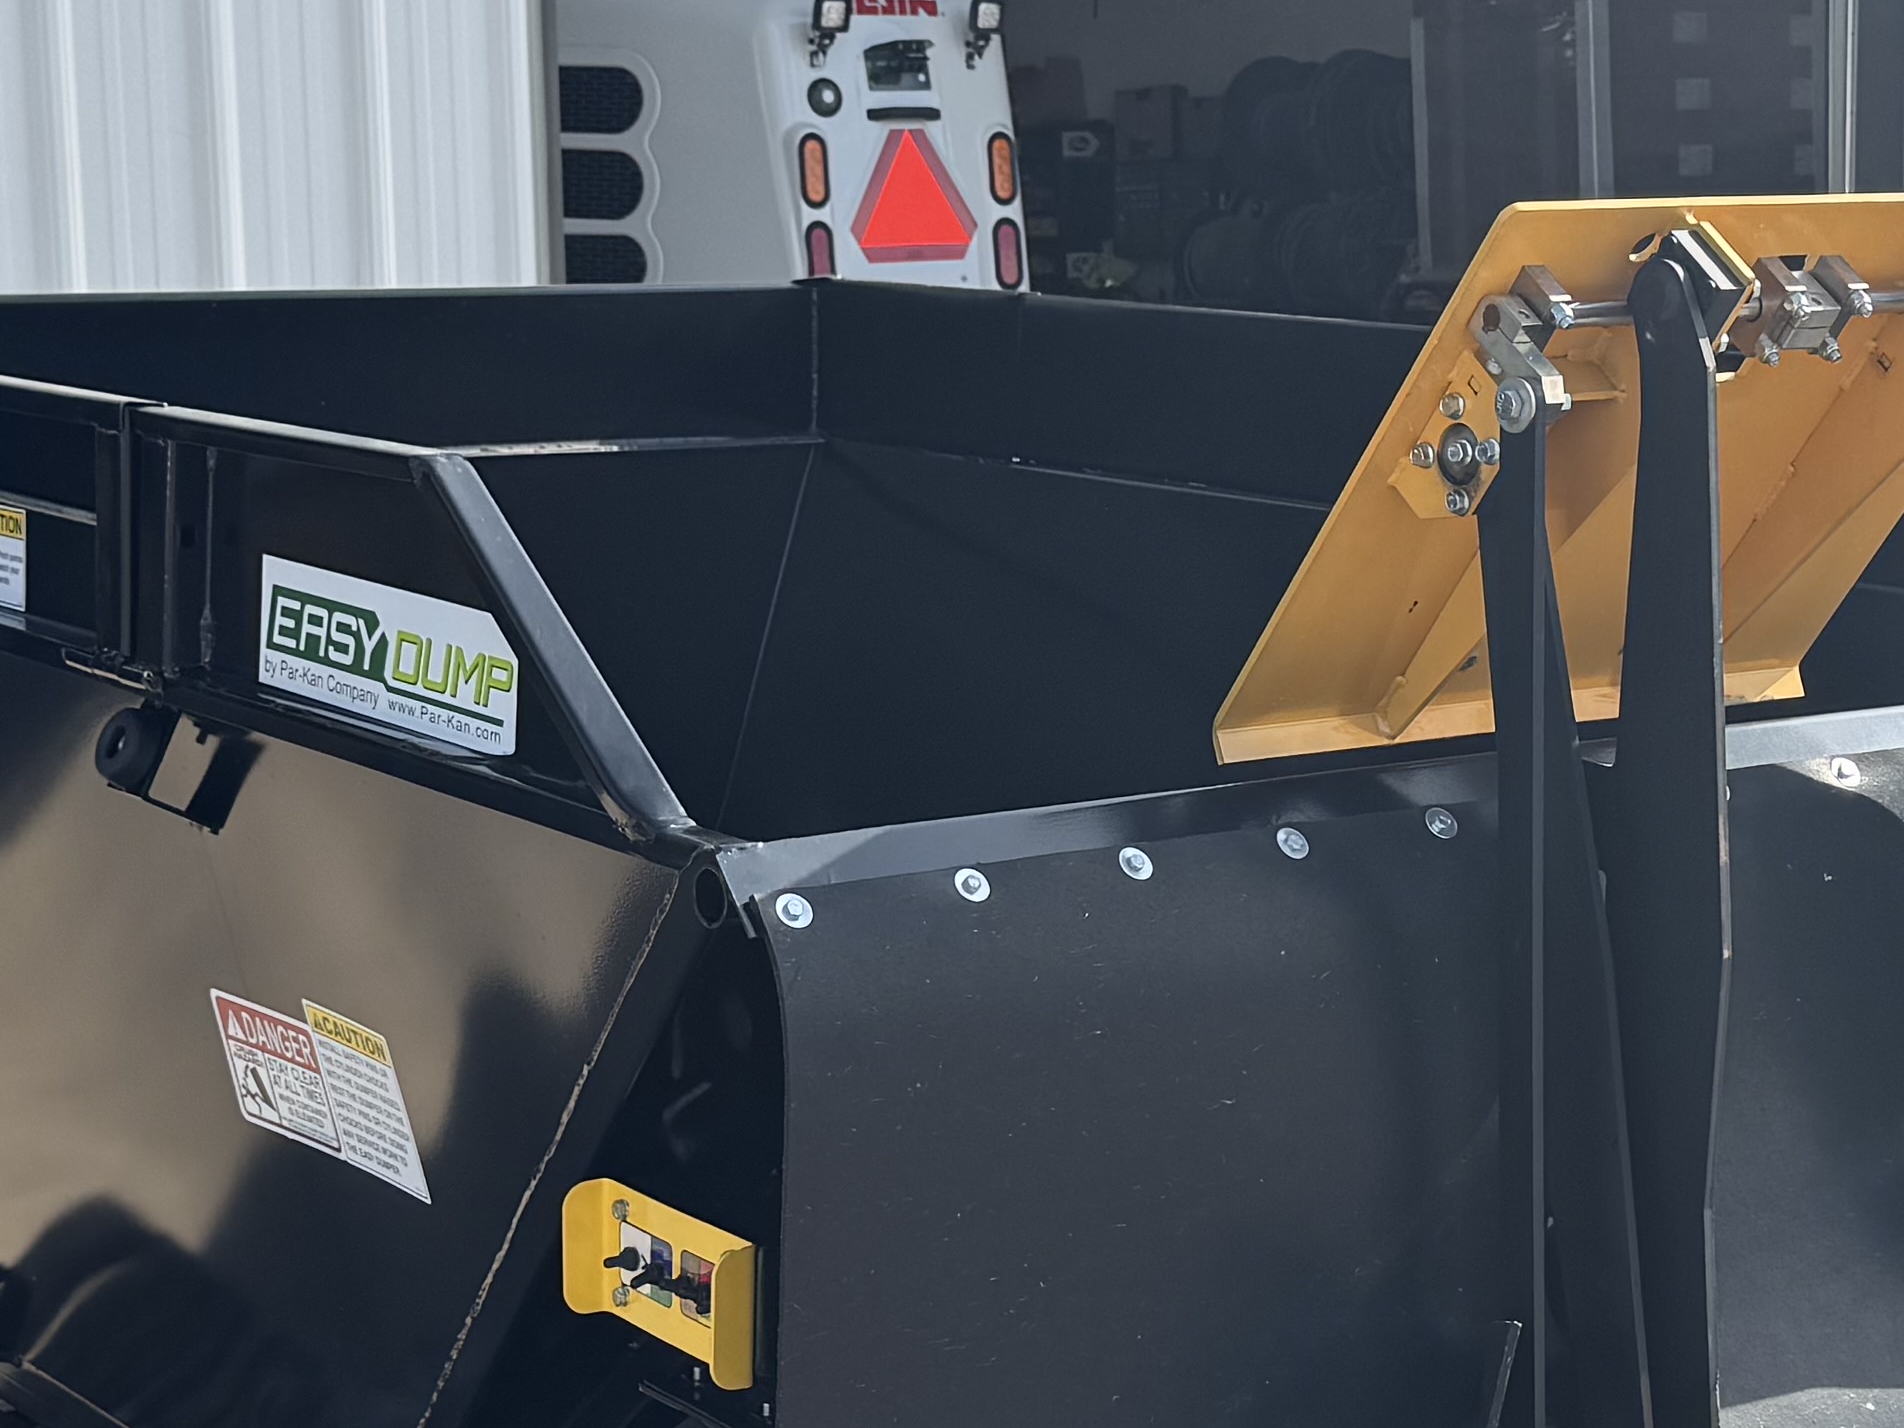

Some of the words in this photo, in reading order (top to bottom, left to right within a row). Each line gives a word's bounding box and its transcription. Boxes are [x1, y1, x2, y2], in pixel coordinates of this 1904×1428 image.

[272, 595, 387, 671] EASY
[392, 629, 515, 709] DUMP
[264, 653, 278, 678] by
[280, 660, 324, 689] Par-Kan
[326, 674, 380, 710] Company
[387, 699, 502, 745] www.Par-Kan.com
[240, 1011, 316, 1069] DANGER
[322, 1016, 387, 1062] CAUTION
